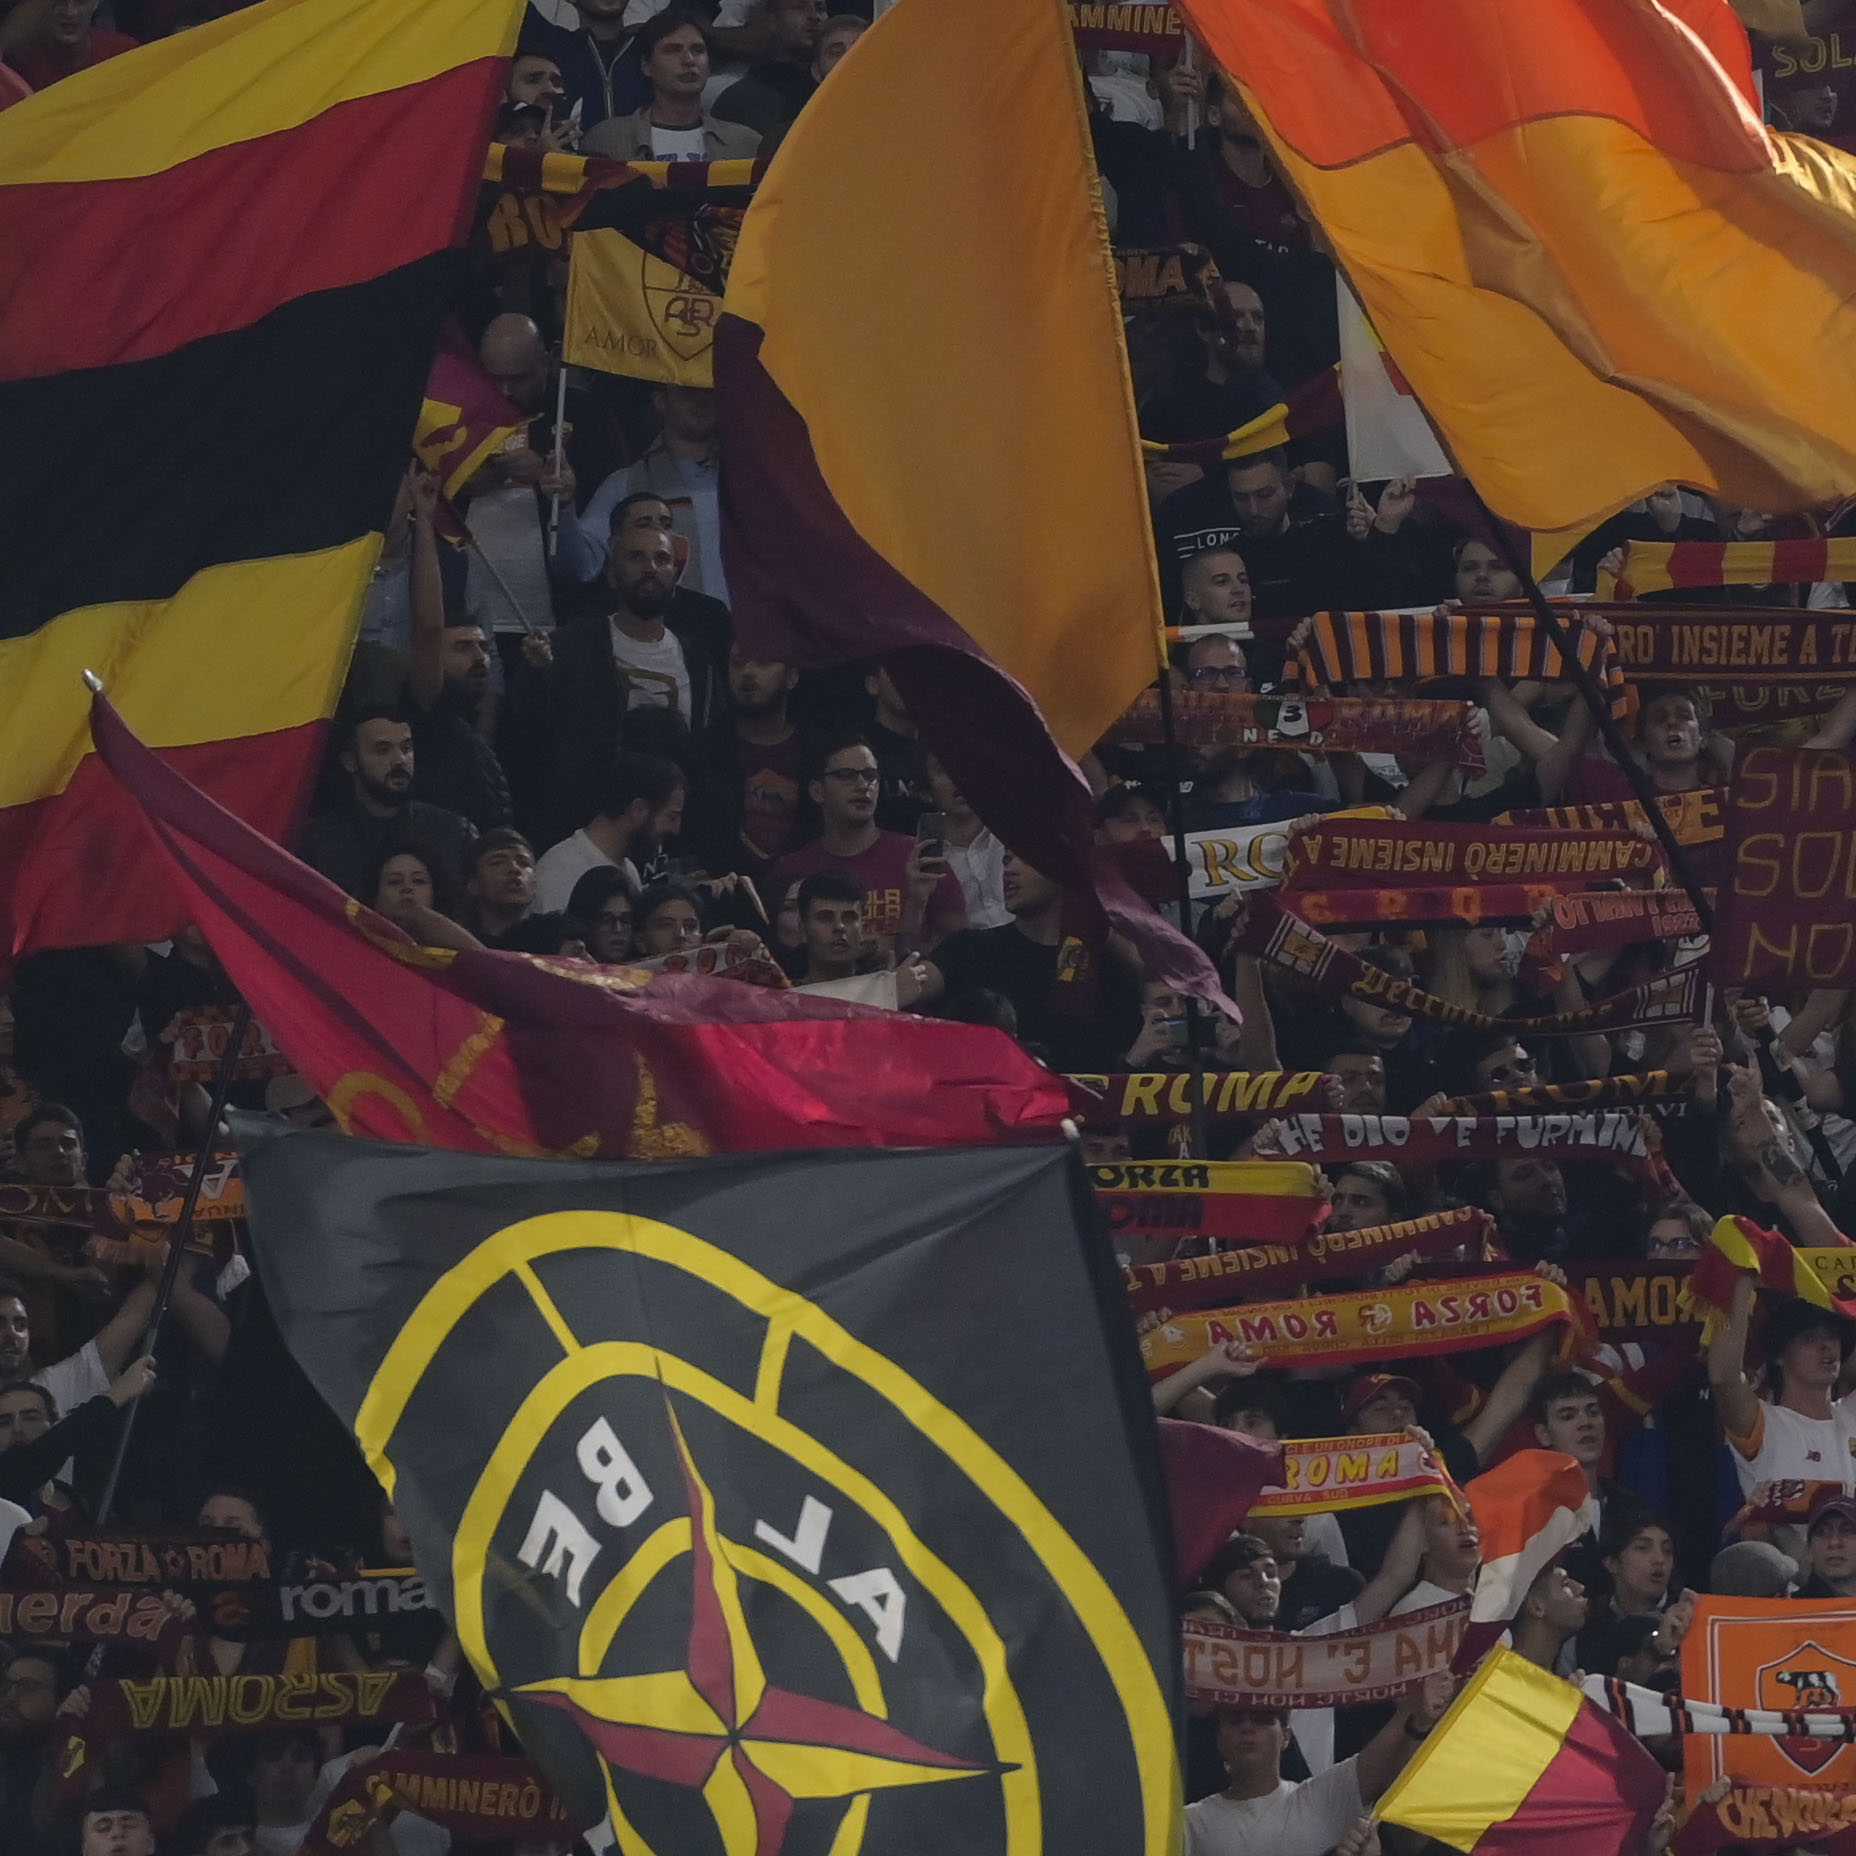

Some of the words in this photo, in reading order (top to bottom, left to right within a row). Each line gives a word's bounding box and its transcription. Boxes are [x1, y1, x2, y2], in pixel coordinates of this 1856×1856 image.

[1671, 623, 1792, 665] INSIEME
[1800, 624, 1819, 665] A
[1331, 837, 1455, 873] INSIEME
[1465, 840, 1654, 882] CAMMINERÒ
[1343, 1114, 1409, 1148] DIO
[66, 1540, 161, 1582] FORZA
[187, 1543, 271, 1581] ROMA
[280, 1578, 438, 1622] roma
